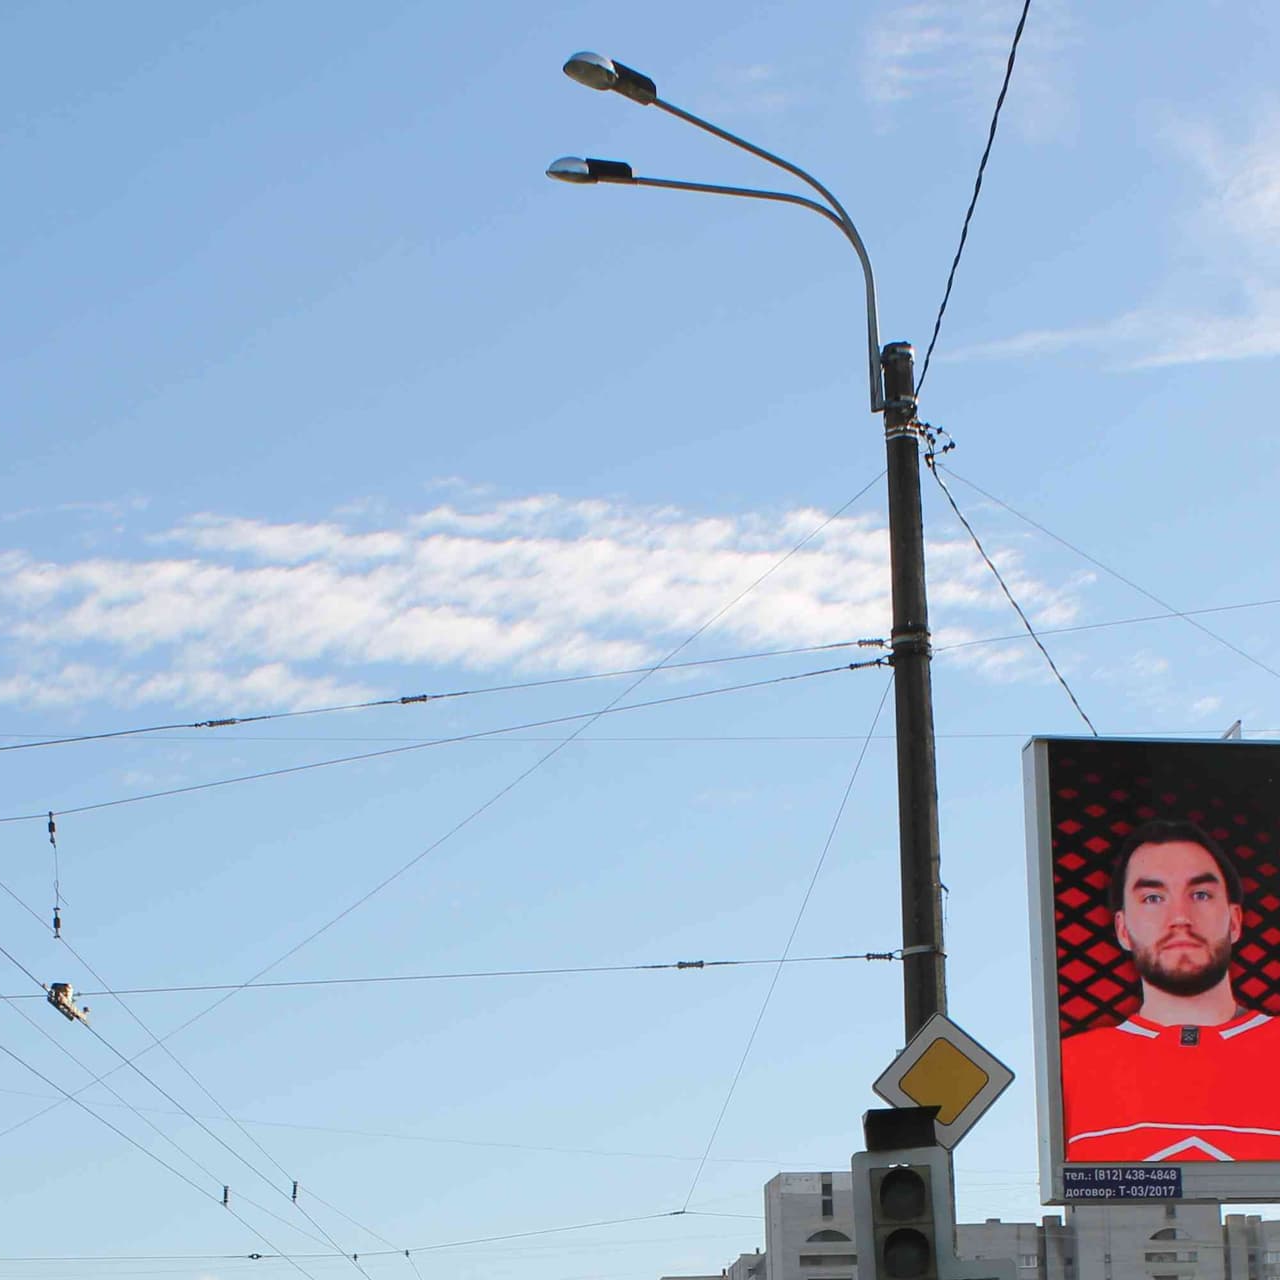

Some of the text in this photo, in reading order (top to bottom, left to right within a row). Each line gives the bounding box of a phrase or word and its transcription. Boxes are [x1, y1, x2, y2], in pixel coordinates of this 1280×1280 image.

[1065, 1169, 1177, 1181] тел.: (812) 438-4848
[1065, 1185, 1175, 1198] договор: Т-03/2017
